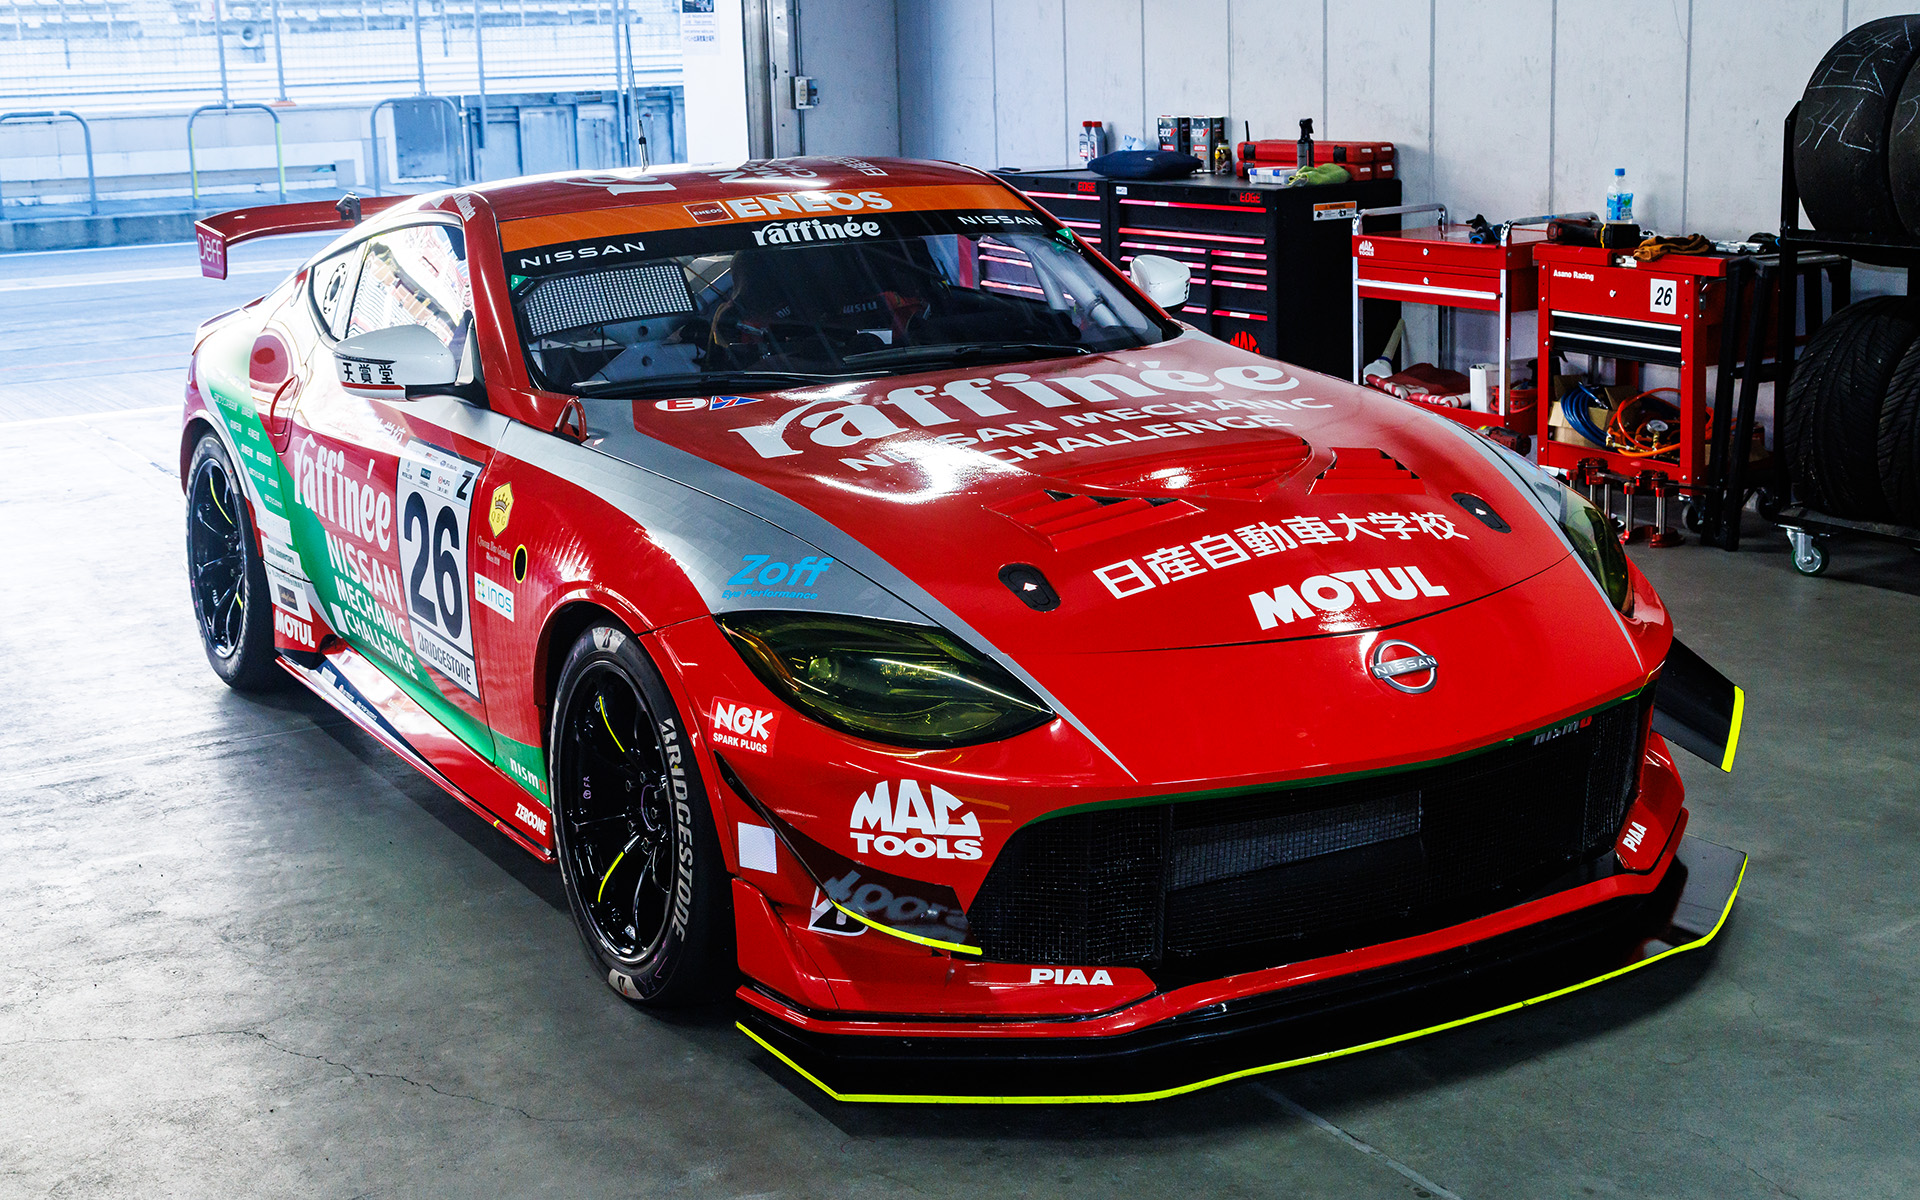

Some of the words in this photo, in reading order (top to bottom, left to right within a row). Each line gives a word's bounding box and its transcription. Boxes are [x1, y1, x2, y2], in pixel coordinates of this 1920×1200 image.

[693, 208, 723, 217] ENEOS
[725, 190, 894, 219] ENEOS
[958, 214, 1043, 227] NISSAN
[520, 241, 645, 269] NISSAN
[1553, 269, 1572, 280] Asano
[1572, 271, 1594, 283] Racing
[1654, 286, 1672, 307] 26
[342, 362, 395, 385] 天賞堂
[1060, 397, 1334, 427] MECHANIC
[456, 470, 475, 501] Z
[325, 530, 404, 611] NISSAN
[403, 491, 464, 641] 26
[727, 554, 835, 587] Zoff
[1092, 511, 1470, 600] 日産自動車大学校
[721, 589, 742, 600] Eye
[744, 588, 819, 600] Performance
[1248, 566, 1450, 631] MOTUL
[335, 576, 411, 647] MECHANIC
[275, 609, 316, 648] MOTUL
[345, 613, 419, 680] CHALLENGE
[417, 631, 473, 687] BRIDGESTONE
[1374, 655, 1438, 678] NISSAN
[712, 701, 775, 742] NGK
[1533, 715, 1593, 746] nismo
[713, 732, 739, 749] SPARK
[740, 738, 768, 755] PLUGS
[509, 757, 548, 796] nismo
[849, 779, 982, 836] MAC
[658, 717, 695, 943] BRIDGESTONE
[1622, 821, 1648, 853] PIAA
[849, 832, 983, 861] TOOLS
[1030, 968, 1114, 985] PIAA
